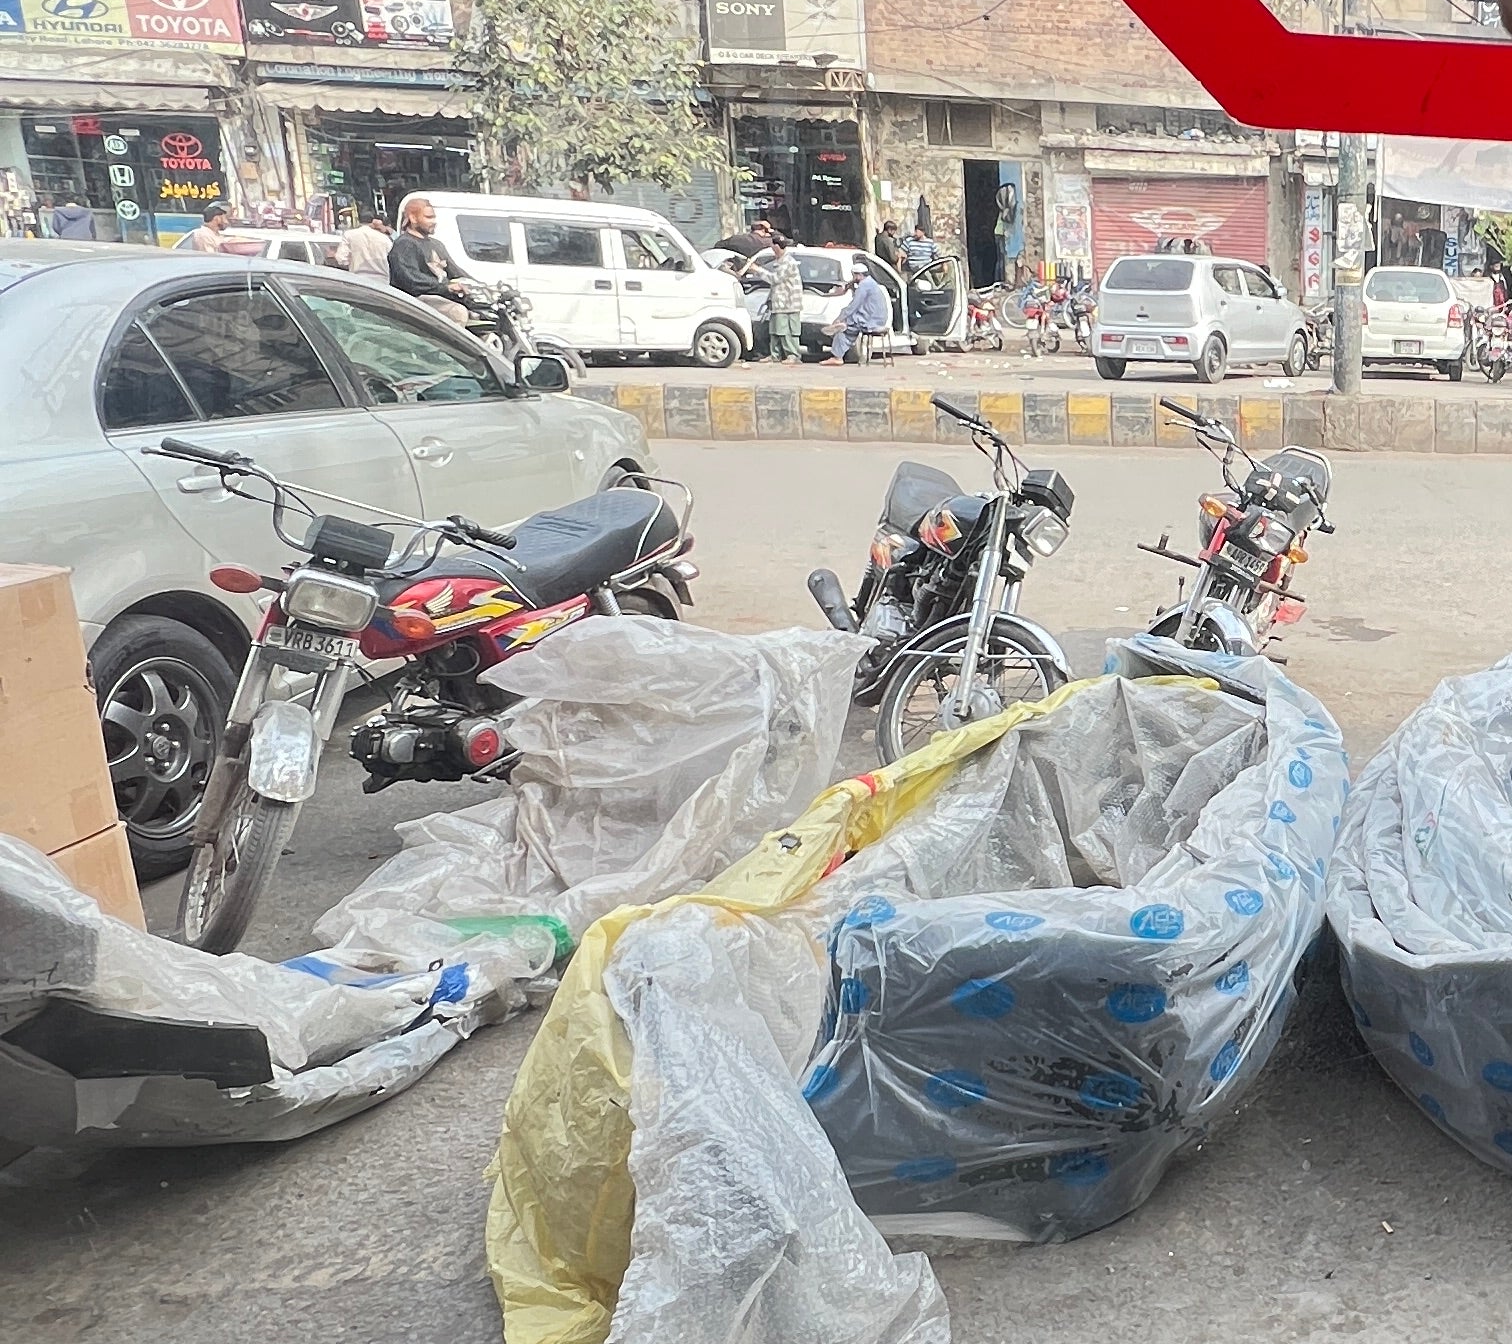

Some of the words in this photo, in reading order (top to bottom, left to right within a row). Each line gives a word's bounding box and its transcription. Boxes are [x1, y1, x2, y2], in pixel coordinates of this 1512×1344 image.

[716, 2, 775, 16] SONY
[33, 19, 123, 34] HYUNDAI
[136, 14, 232, 38] TOYOTA
[74, 37, 112, 46] Lahore
[160, 158, 212, 170] TOYOTA
[285, 628, 313, 650] VRB
[315, 636, 354, 658] 3611
